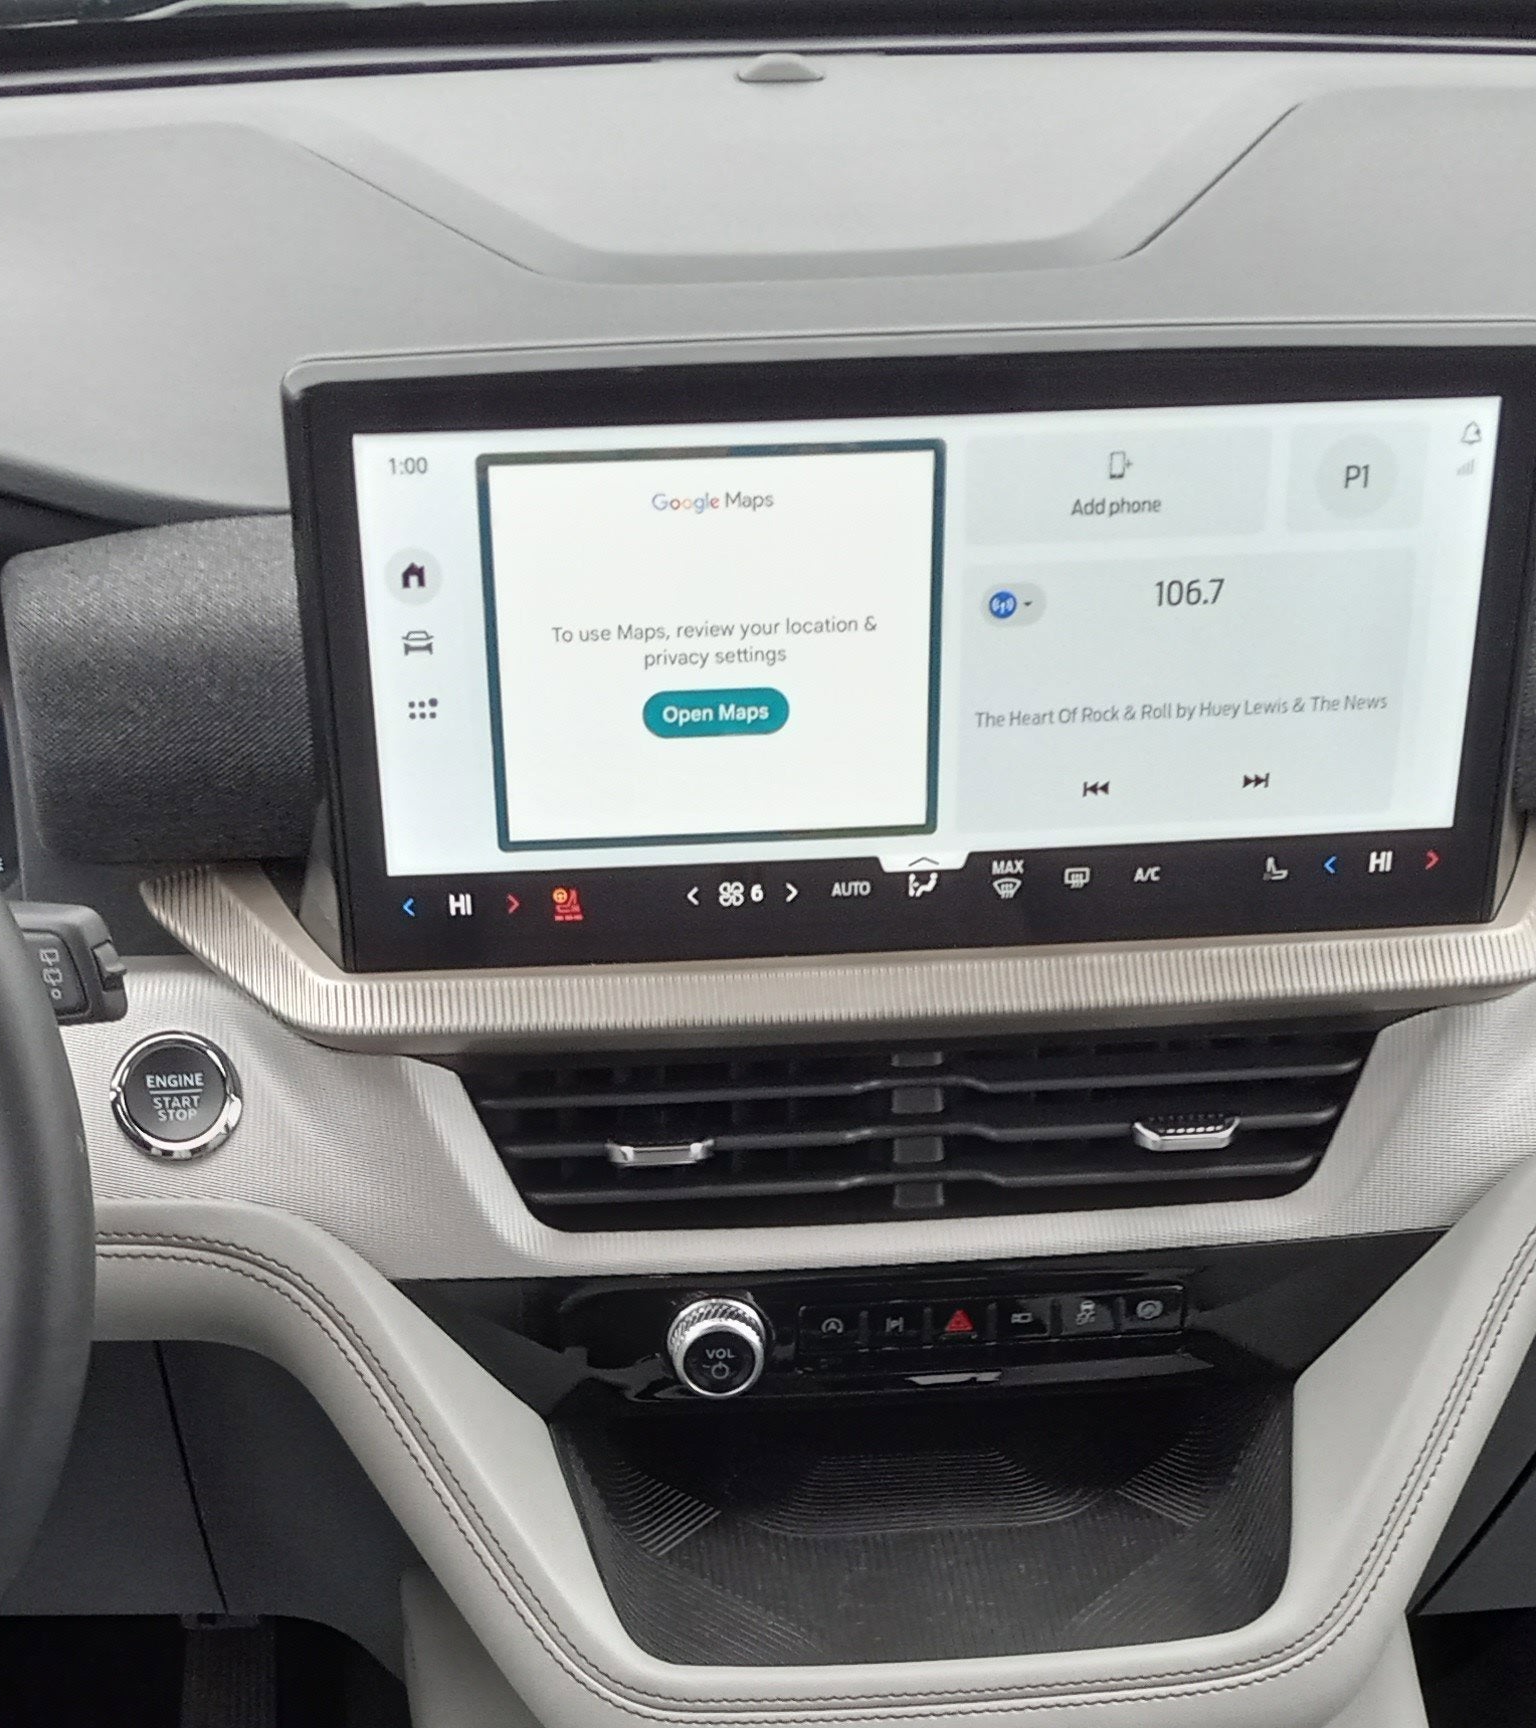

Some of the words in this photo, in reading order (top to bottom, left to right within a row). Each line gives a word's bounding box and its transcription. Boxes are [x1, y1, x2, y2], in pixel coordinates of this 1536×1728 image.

[389, 457, 428, 475] 1:00
[1343, 464, 1371, 489] P1
[651, 492, 720, 514] Google
[724, 491, 774, 511] Maps
[1071, 497, 1105, 516] Add
[1109, 497, 1162, 517] phone
[1155, 578, 1224, 606] 106.7
[552, 626, 573, 643] To
[579, 627, 611, 642] use
[617, 624, 671, 643] Maps,
[676, 620, 735, 639] review
[740, 620, 780, 641] your
[786, 617, 858, 635] location
[864, 615, 878, 632] &
[644, 649, 710, 671] privacy
[715, 646, 788, 666] settings
[662, 704, 713, 727] Open
[718, 702, 770, 724] Maps
[975, 711, 1005, 728] The
[1008, 710, 1054, 726] Heart
[1058, 706, 1078, 724] Of
[1081, 705, 1119, 722] Rock
[1124, 704, 1136, 720] &
[1141, 702, 1172, 720] Roll
[1175, 702, 1195, 721] by
[1199, 701, 1241, 718] Huey
[1244, 699, 1288, 716] Lewis
[1292, 697, 1305, 713] &
[1311, 695, 1340, 712] The
[1344, 694, 1388, 711] News
[992, 859, 1024, 875] MAX
[1368, 851, 1393, 873] HI
[1134, 865, 1160, 883] A/C
[751, 883, 764, 902] 6
[831, 880, 871, 898] AUTO
[448, 892, 473, 916] HI
[145, 1072, 204, 1088] ENGINE
[153, 1095, 200, 1109] START
[157, 1109, 198, 1121] STOP
[705, 1348, 735, 1359] VOL
